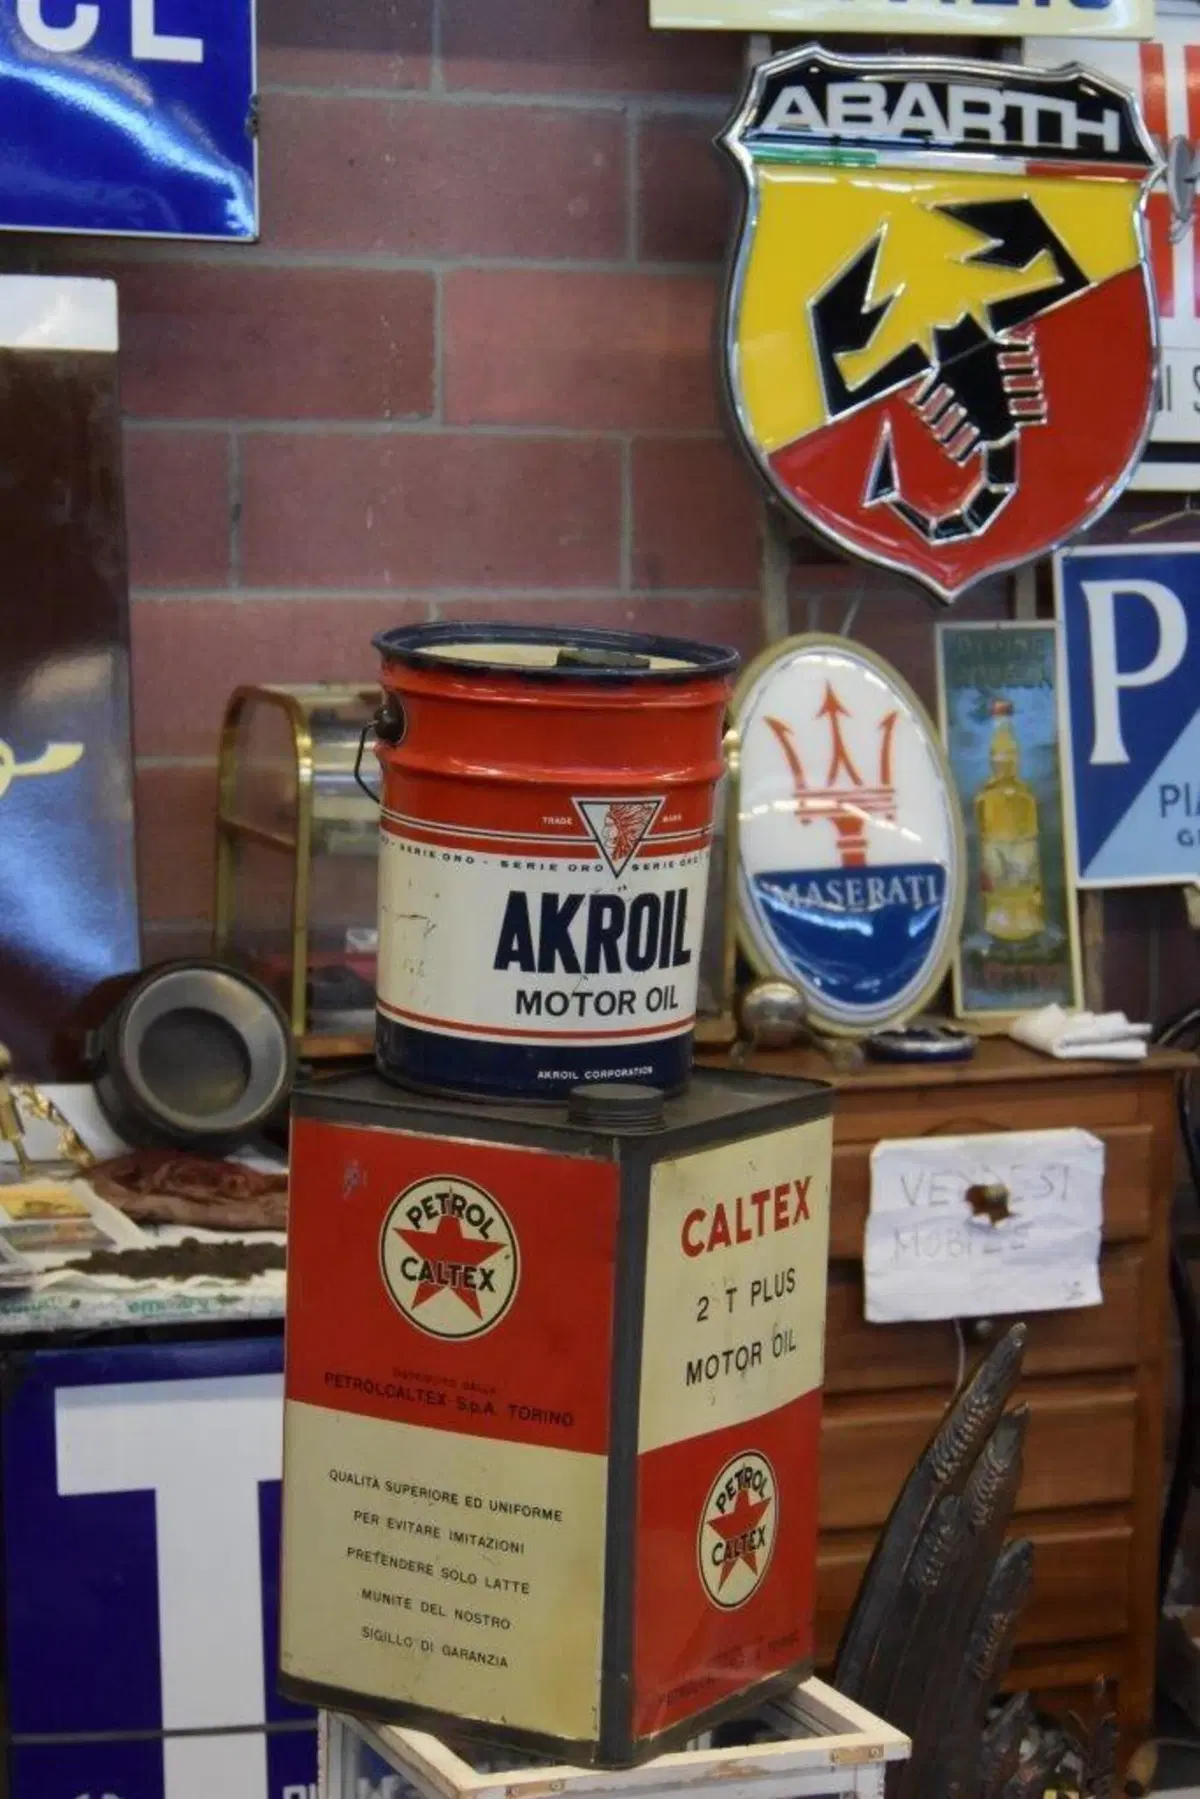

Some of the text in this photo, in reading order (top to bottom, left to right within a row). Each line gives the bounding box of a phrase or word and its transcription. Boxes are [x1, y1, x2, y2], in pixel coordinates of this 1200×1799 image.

[763, 81, 1121, 153] ABARTH
[1080, 578, 1189, 766] P
[542, 816, 574, 826] TRADE
[1160, 783, 1200, 818] PI
[1177, 827, 1200, 848] G
[501, 859, 558, 873] SERIE
[568, 863, 604, 873] ORO
[778, 874, 941, 911] MASERATI
[494, 886, 692, 975] AKROIL
[515, 985, 679, 1017] MOTOR OIL
[537, 1065, 653, 1080] AKROIL CORPORATION
[405, 1192, 495, 1241] PETROL
[681, 1175, 813, 1258] CALTEX
[401, 1256, 497, 1294] CALTEX
[697, 1267, 796, 1322] 2 T PLUS
[686, 1328, 797, 1387] MOTOR OIL
[508, 1403, 575, 1428] TORINO
[384, 1480, 460, 1506] SUPERIORE
[464, 1496, 483, 1509] ED
[489, 1499, 564, 1523] UNIFORME
[712, 1466, 768, 1567] PETROL CALTEX
[353, 1510, 525, 1555] PER EVITARE IMITAZIONI
[346, 1547, 530, 1595] PRETENDERE SOLO LATTE
[361, 1588, 511, 1631] MUNITE DEL NOSTRO
[361, 1625, 509, 1669] SIGILLO DI GARANZIA
